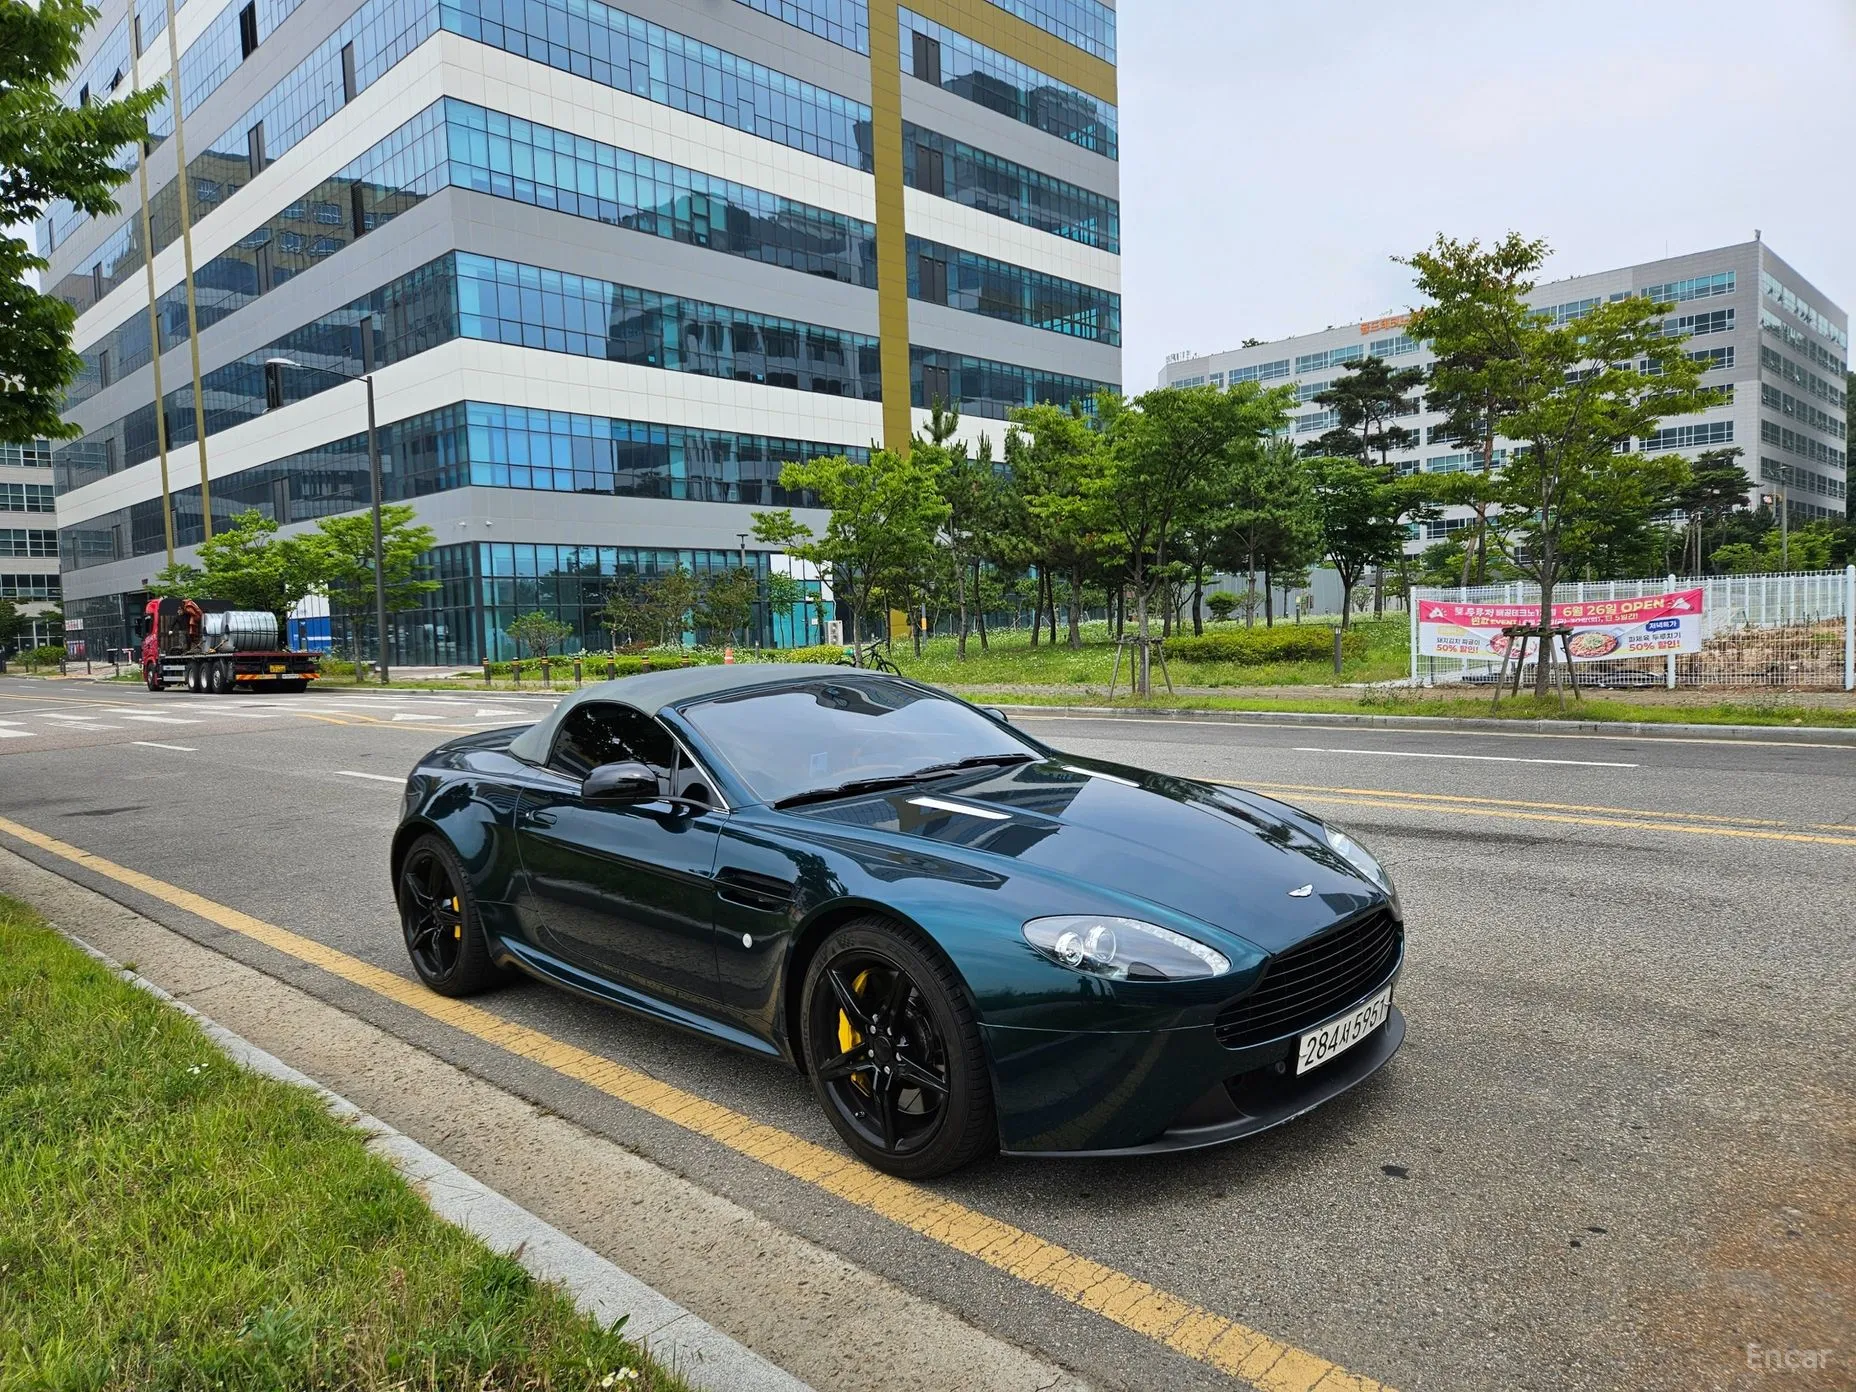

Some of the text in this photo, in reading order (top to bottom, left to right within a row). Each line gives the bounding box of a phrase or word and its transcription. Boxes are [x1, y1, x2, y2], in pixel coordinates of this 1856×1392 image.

[1563, 606, 1584, 617] 6월
[1587, 603, 1617, 616] 26일
[1621, 598, 1665, 613] OPEN
[1648, 620, 1677, 630] 저녁특가
[1652, 632, 1682, 641] 두루치기
[1436, 643, 1479, 654] 50% 할인!
[1629, 639, 1681, 652] 50% 할인!
